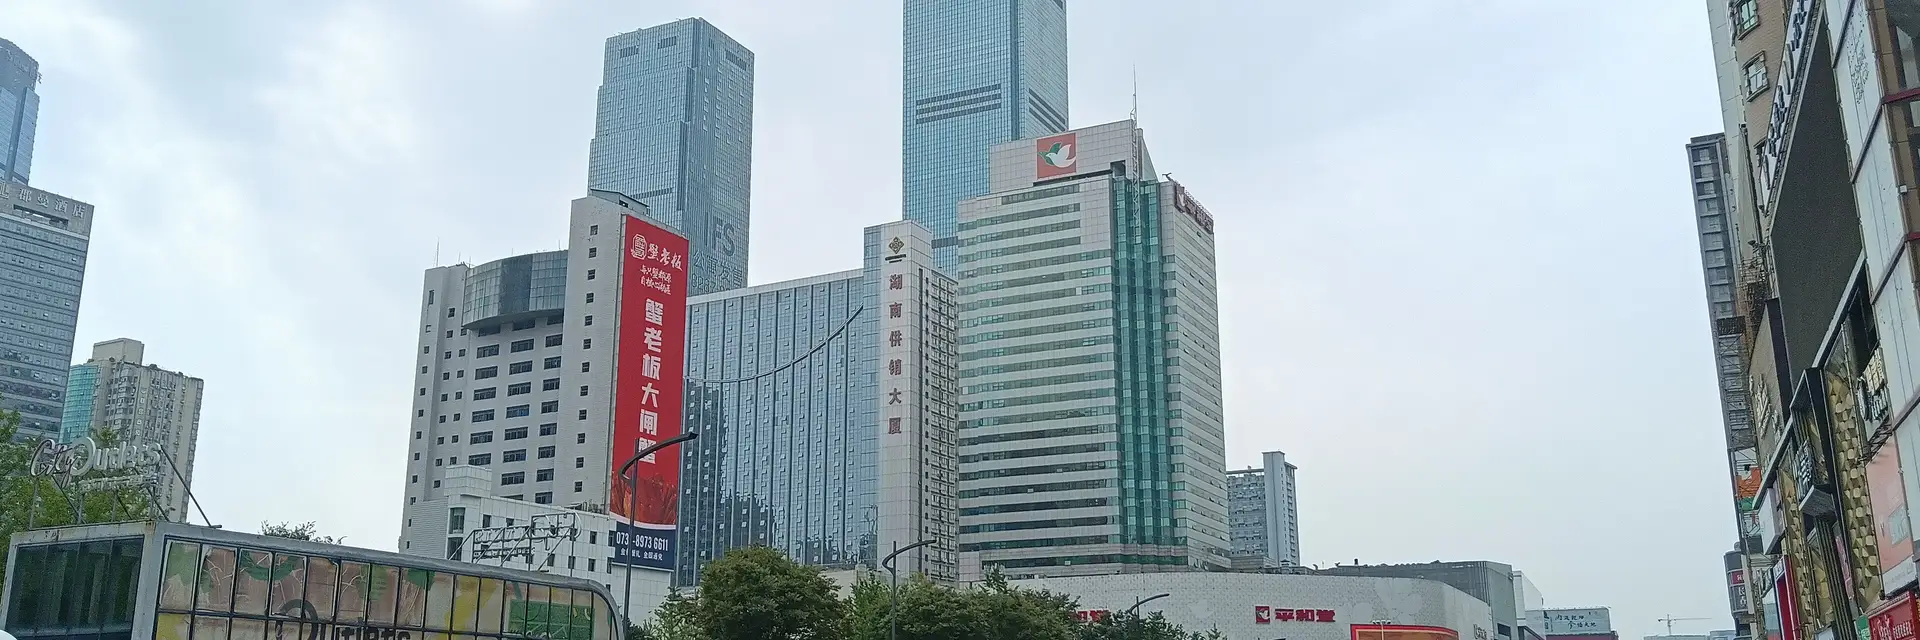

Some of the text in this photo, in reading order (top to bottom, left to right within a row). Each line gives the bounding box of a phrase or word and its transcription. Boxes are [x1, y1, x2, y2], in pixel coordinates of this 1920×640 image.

[637, 299, 664, 464] 蟹老板大闸蟹
[888, 273, 903, 435] 湖南供销大厦
[616, 532, 668, 551] 073-8973 6611
[1274, 608, 1336, 623] 平和堂
